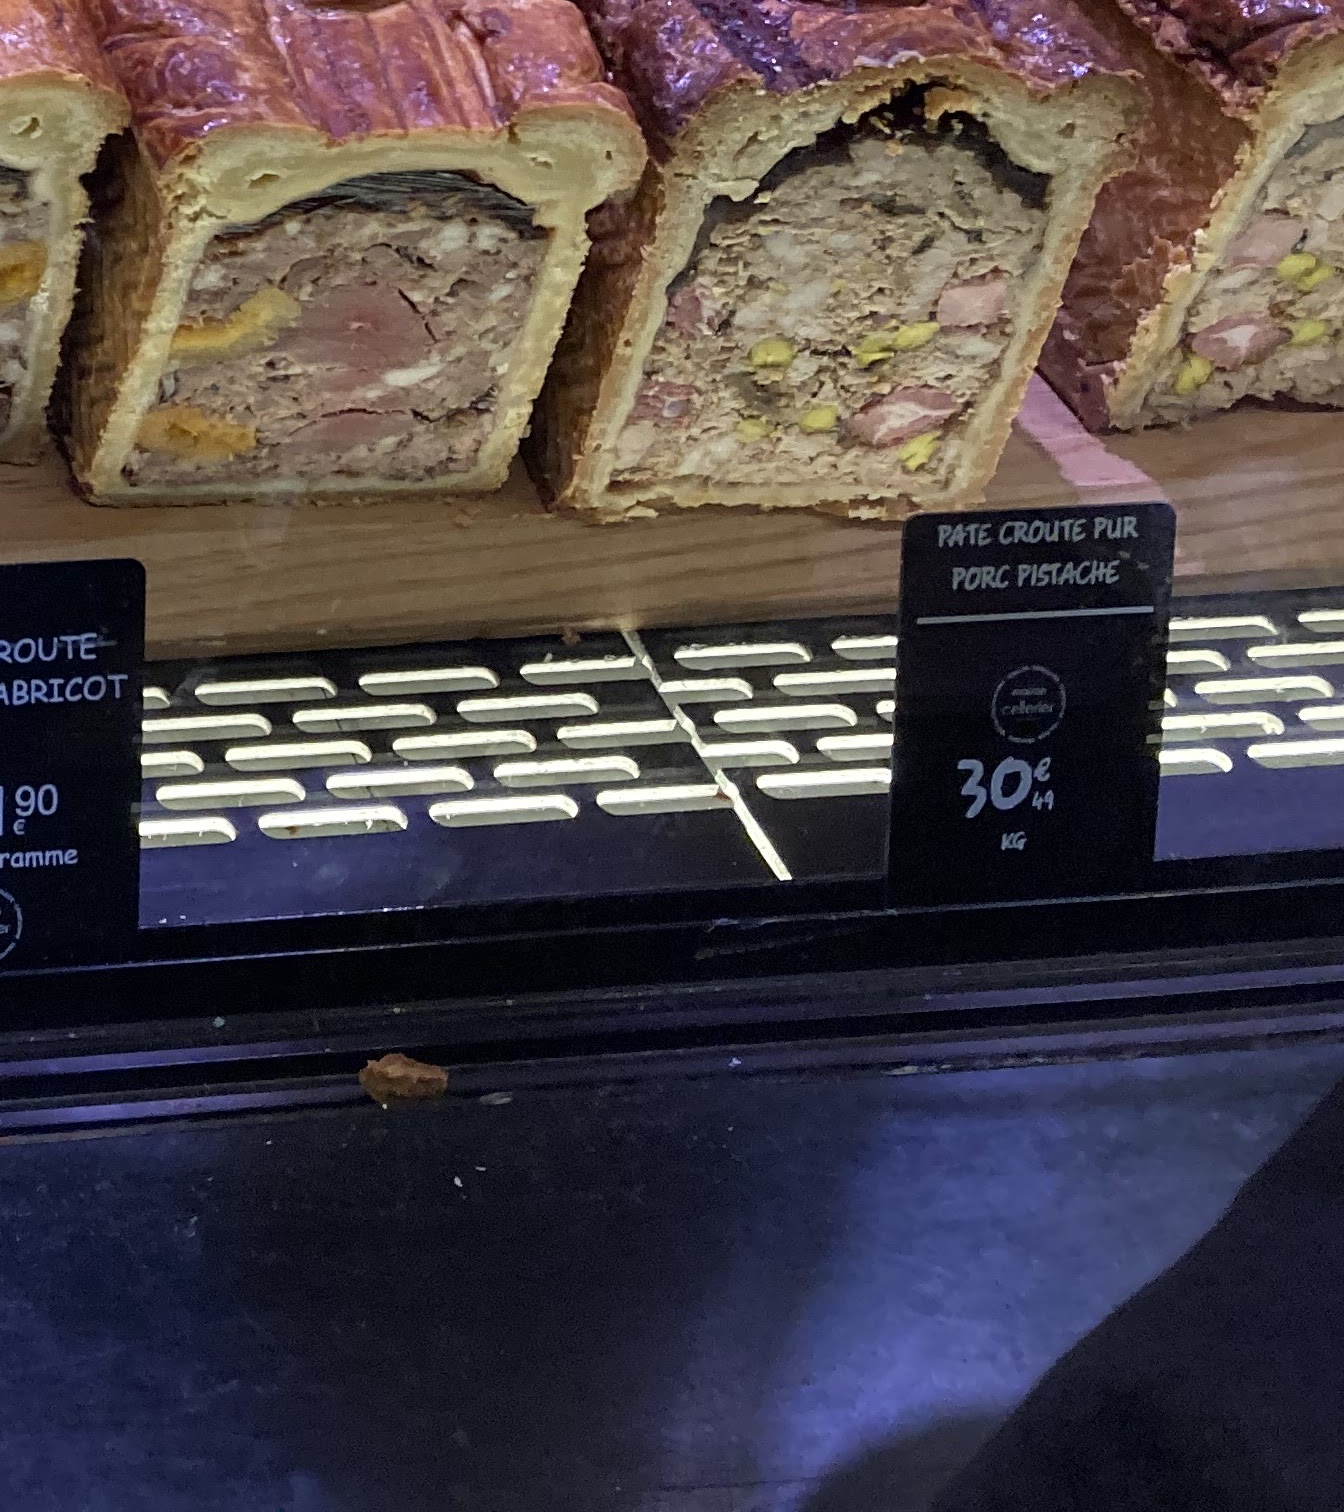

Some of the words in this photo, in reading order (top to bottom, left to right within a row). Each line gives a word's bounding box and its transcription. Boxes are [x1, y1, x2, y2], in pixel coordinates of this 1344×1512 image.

[938, 523, 992, 547] PATE
[999, 518, 1086, 545] CROUTE
[1094, 516, 1138, 539] PUR
[952, 565, 1009, 591] PORC
[1017, 559, 1120, 587] PISTACHE
[1001, 832, 1027, 851] KG
